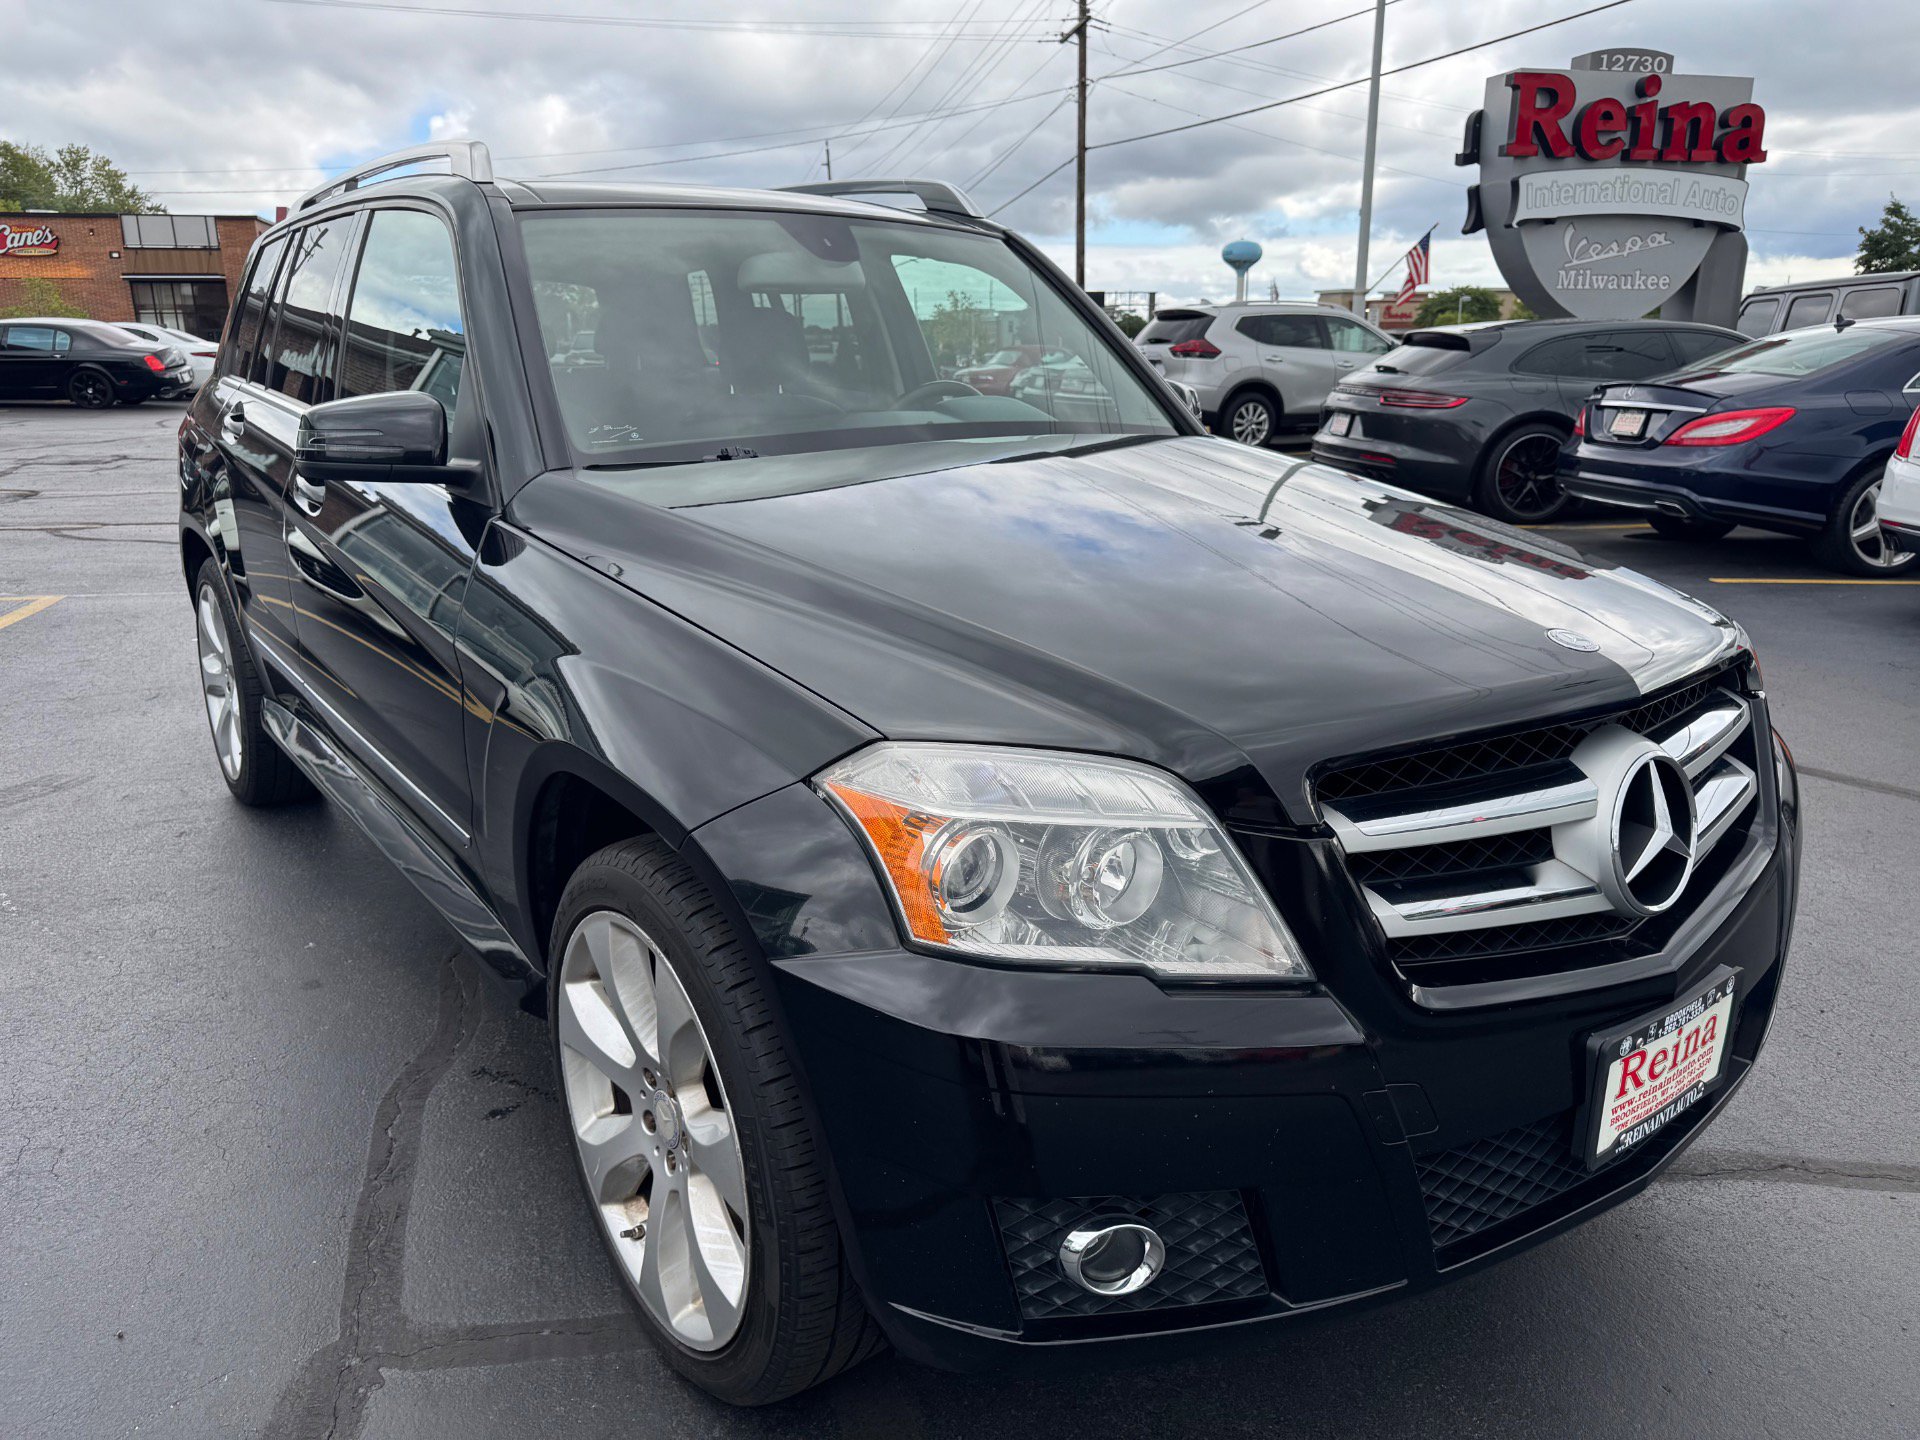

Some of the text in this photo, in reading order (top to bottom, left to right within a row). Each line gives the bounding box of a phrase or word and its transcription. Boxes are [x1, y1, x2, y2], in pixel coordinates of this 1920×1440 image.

[1599, 53, 1668, 74] 12730
[1499, 72, 1768, 164] Reina
[1526, 175, 1740, 215] International Auto
[1563, 222, 1675, 267] Vespa
[1556, 270, 1671, 290] Milwaukee
[1664, 997, 1703, 1026] BROOKFIELD
[1613, 1014, 1718, 1102] Reina
[1611, 1045, 1714, 1116] www.reinaintlauto.com
[1609, 1095, 1658, 1127] BROOKFIELD,
